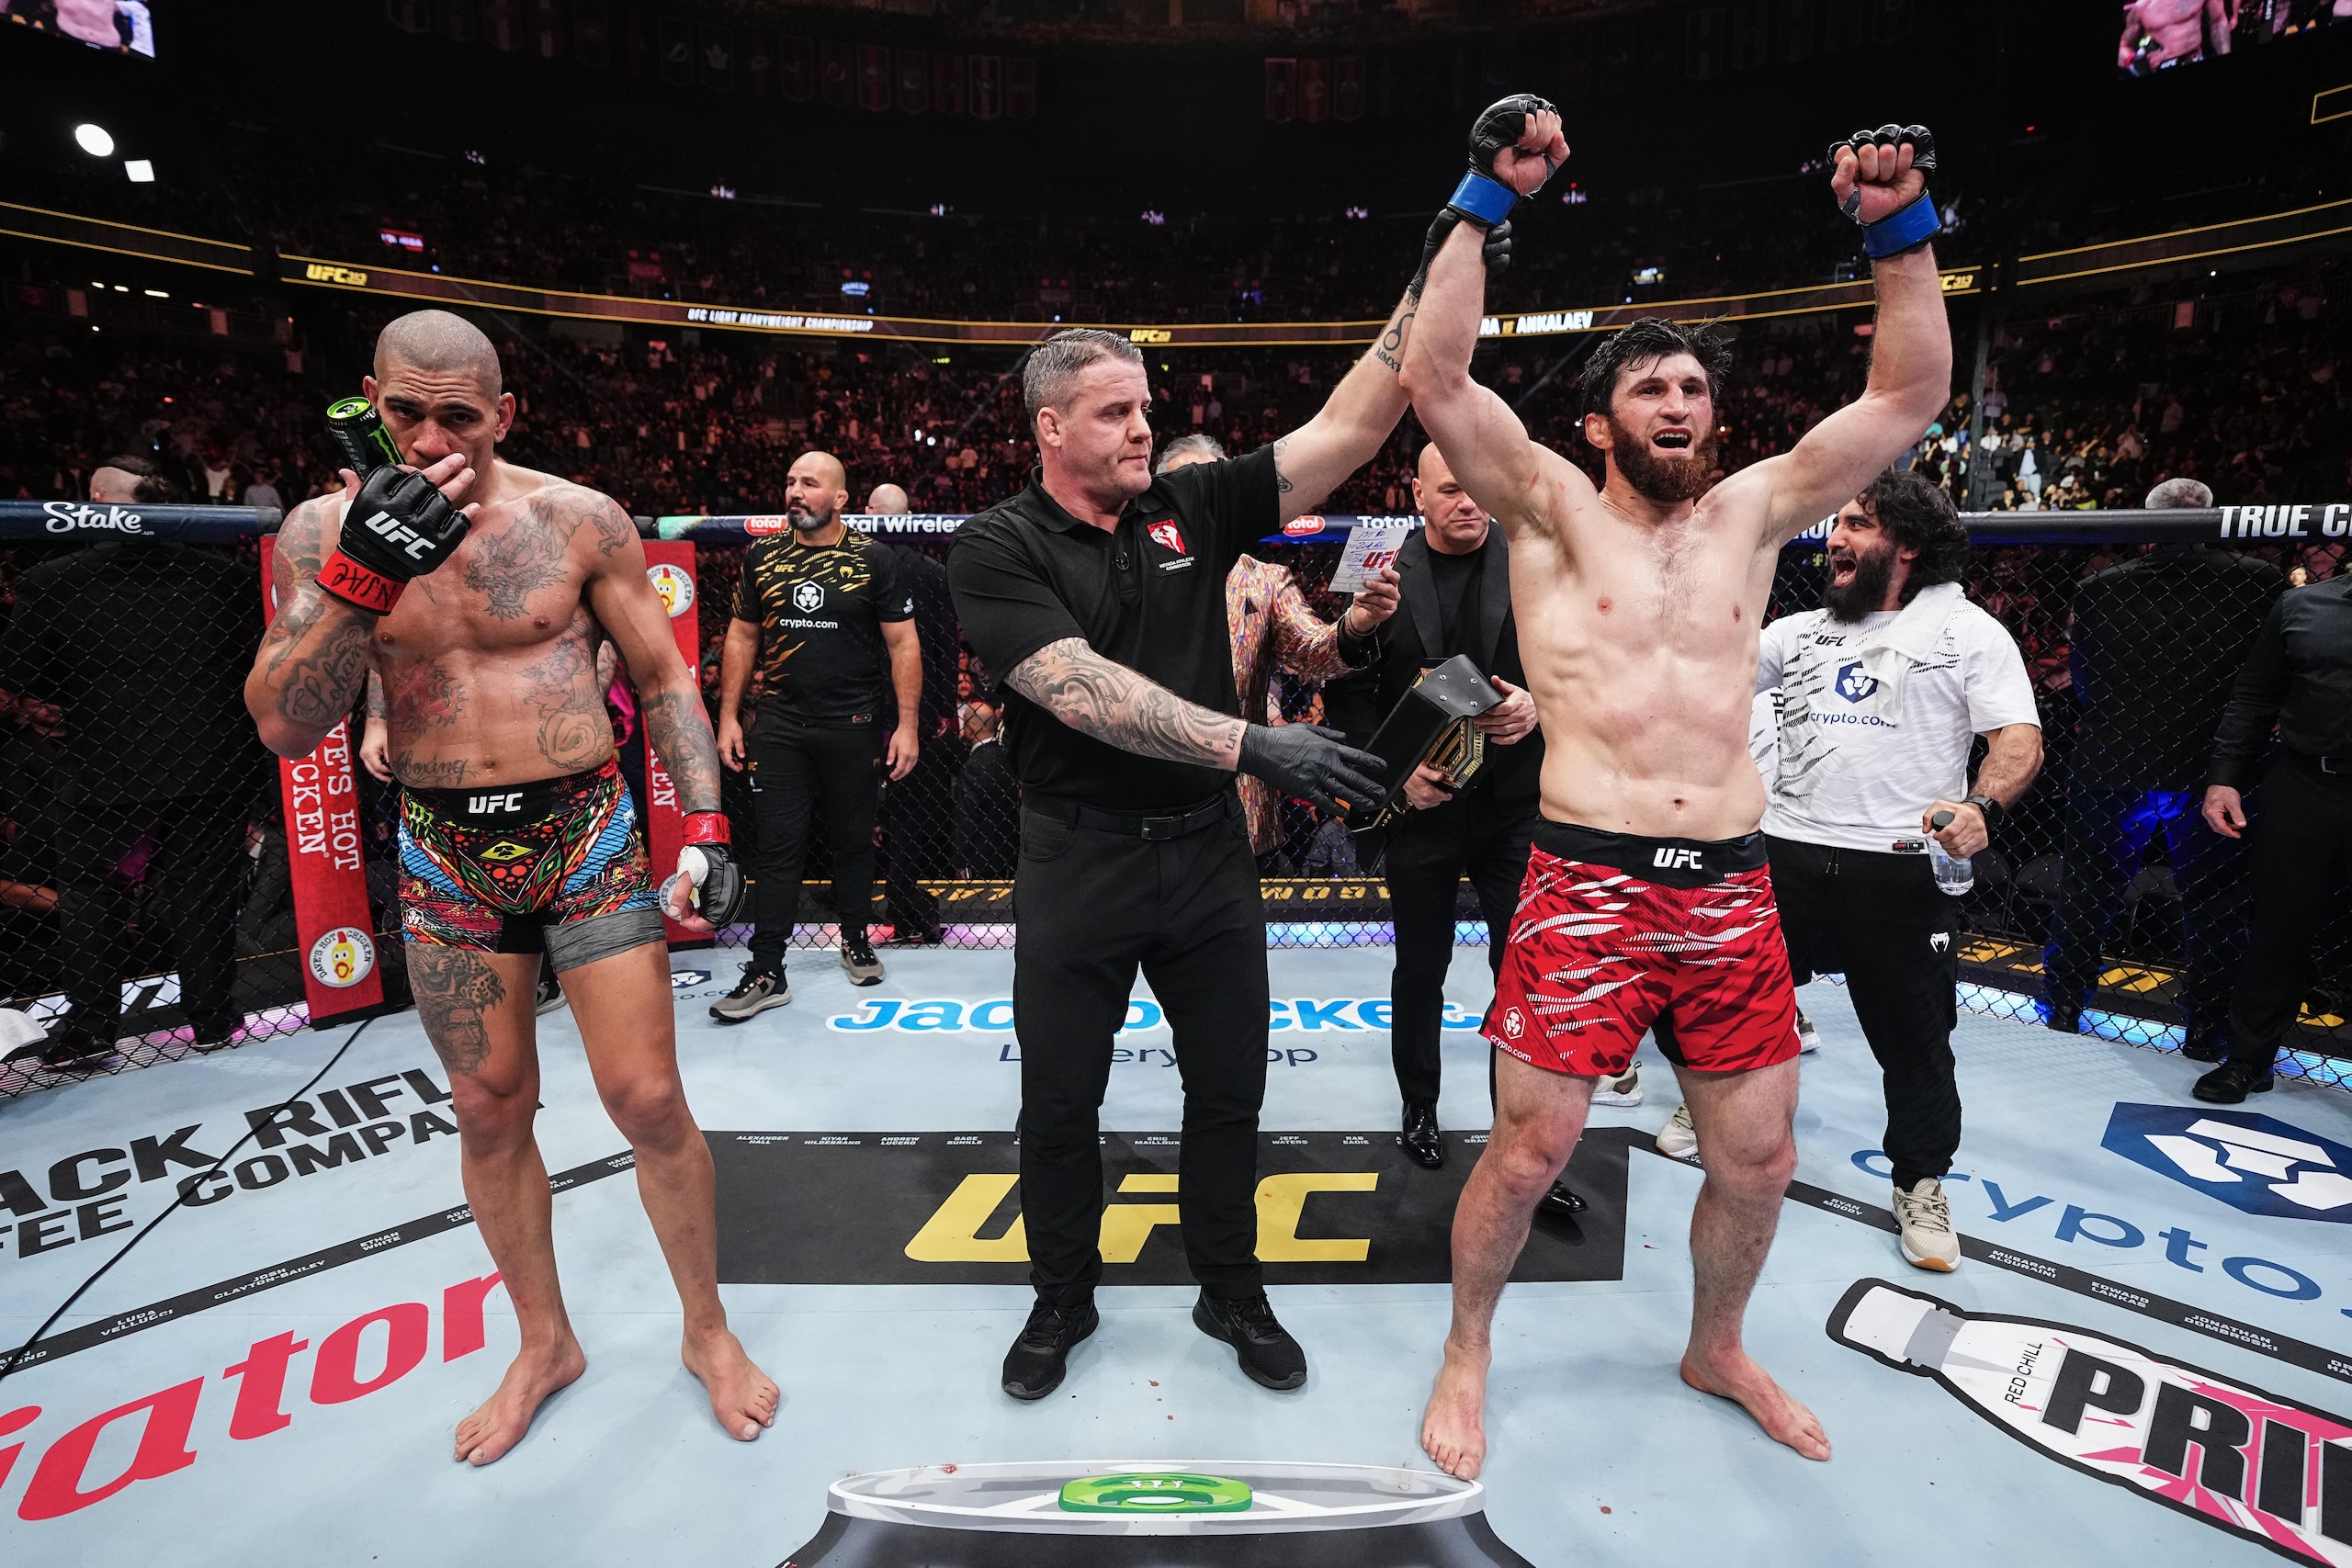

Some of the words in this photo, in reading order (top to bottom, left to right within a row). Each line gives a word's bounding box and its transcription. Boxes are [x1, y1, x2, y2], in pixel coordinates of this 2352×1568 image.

[306, 263, 348, 283] UFC
[709, 309, 738, 323] LIGHT
[740, 312, 804, 328] HEAVYWEIGHT
[805, 316, 874, 333] CHAMPIONSHIP
[1516, 310, 1594, 334] ANKALAEV
[1130, 329, 1159, 343] UFC
[42, 501, 142, 534] Stake
[750, 517, 782, 529] total
[881, 516, 967, 534] Wireles
[1357, 515, 1416, 530] Total
[2218, 504, 2312, 538] TRUE
[2322, 503, 2352, 537] C
[365, 510, 436, 560] UFC
[774, 563, 797, 574] UFC
[671, 568, 692, 603] CHICKEN
[779, 617, 839, 630] crypto.com
[1815, 635, 1848, 647] UFC
[1810, 712, 1897, 729] crypto.co
[1225, 722, 1240, 751] LIVE
[468, 792, 524, 815] UFC
[330, 807, 360, 872] HOT
[1653, 847, 1703, 870] UFC
[312, 949, 328, 978] DAVE'S
[321, 933, 337, 950] HOT
[345, 930, 372, 963] CHICKEN
[1489, 1033, 1532, 1063] crypto.com
[243, 1068, 458, 1150] RIFL
[606, 1154, 635, 1167] HARR
[1822, 1200, 1863, 1216] MOODY
[1830, 1198, 1860, 1211] RYAN
[359, 1231, 400, 1247] ETHAN
[362, 1235, 401, 1251] WHITE
[1992, 1249, 2057, 1273] MUBARAK
[213, 1259, 326, 1301] CLAYTON-BAILEY
[253, 1268, 287, 1282] JOSH
[2091, 1280, 2150, 1304] EDWARD
[2091, 1286, 2147, 1309] LANKAS
[100, 1308, 175, 1337] VELLUCCI
[117, 1309, 157, 1326] LUCA
[2191, 1314, 2271, 1344] JONATHAN
[2184, 1316, 2278, 1352] DOMBROSKI
[2004, 1376, 2028, 1406] RED
[2017, 1343, 2043, 1376] CHILL
